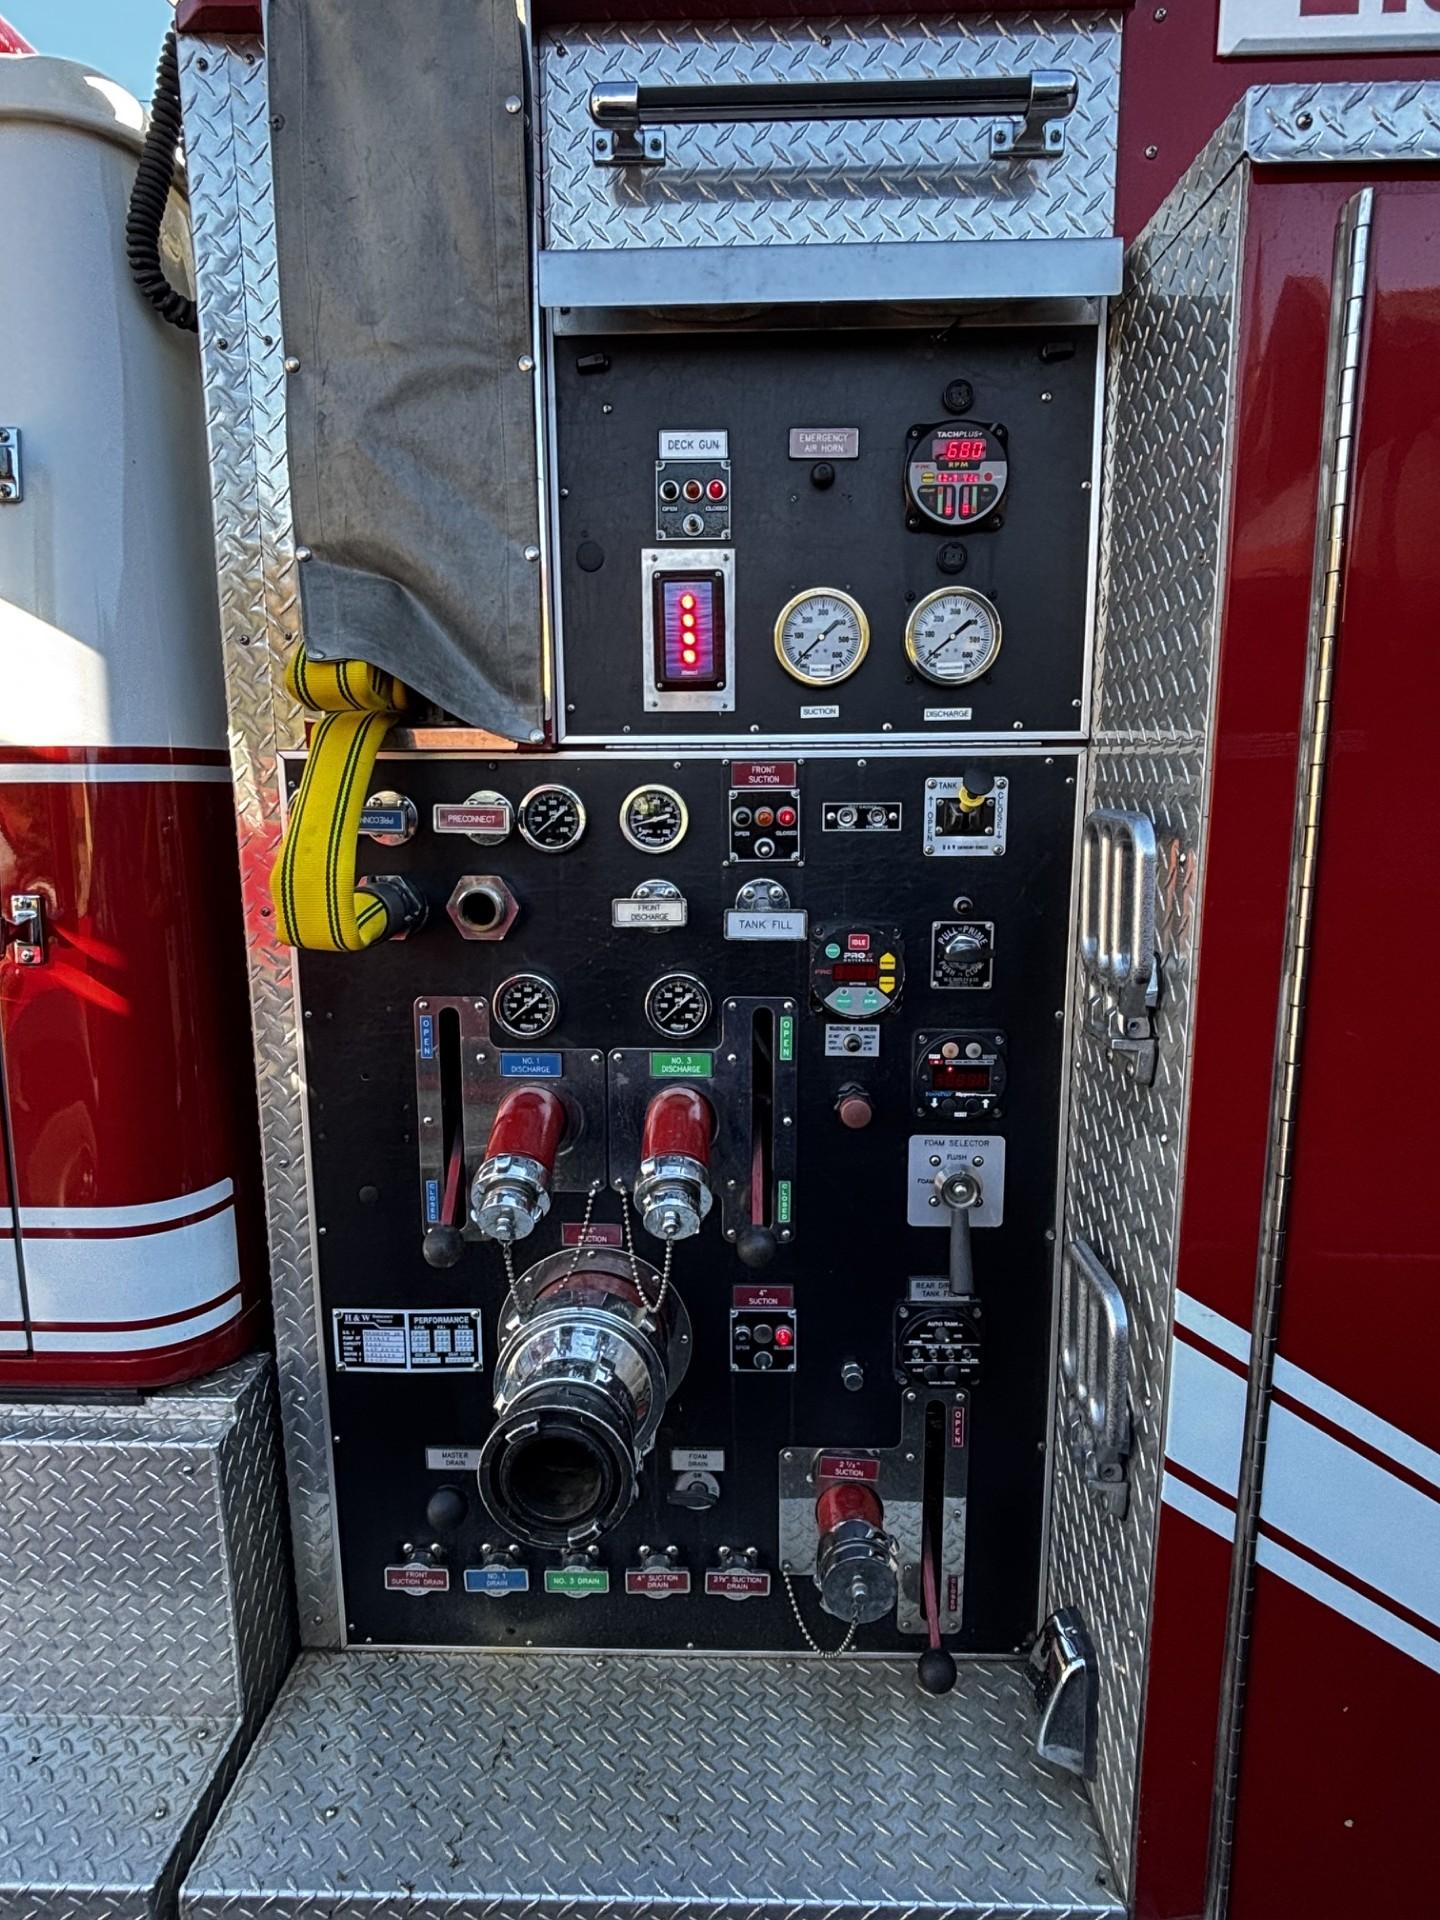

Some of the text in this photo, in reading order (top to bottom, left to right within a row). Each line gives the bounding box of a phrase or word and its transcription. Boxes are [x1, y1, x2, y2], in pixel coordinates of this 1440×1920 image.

[799, 433, 849, 443] EMERGENCY
[668, 440, 720, 450] DECK GUN
[804, 444, 844, 453] AIR HORN
[802, 708, 836, 716] SUCTION
[926, 709, 969, 718] DISCHARGE
[751, 765, 776, 774] FRONT
[748, 775, 780, 784] SUCTION
[938, 781, 958, 790] TANK
[360, 816, 394, 825] PRECONN
[447, 814, 496, 824] PRECONNECT
[630, 913, 670, 921] DISCHARGE
[738, 919, 793, 930] TANK FILL
[422, 1020, 430, 1055] OPEN
[522, 1057, 534, 1065] NO.
[510, 1065, 551, 1073] DISCHARGE
[661, 1065, 701, 1073] DISCHARGE
[924, 1139, 945, 1147] FOAM
[946, 1153, 967, 1161] FLUSH
[578, 1235, 608, 1243] UCTION
[748, 1297, 778, 1305] SUCTION
[344, 1314, 352, 1322] H
[361, 1313, 371, 1321] W
[413, 1316, 470, 1324] PERFORMANCE
[441, 1451, 469, 1459] MASTER
[445, 1459, 466, 1467] DRAIN
[835, 1468, 864, 1477] SUCTION
[578, 1577, 600, 1585] DRAIN
